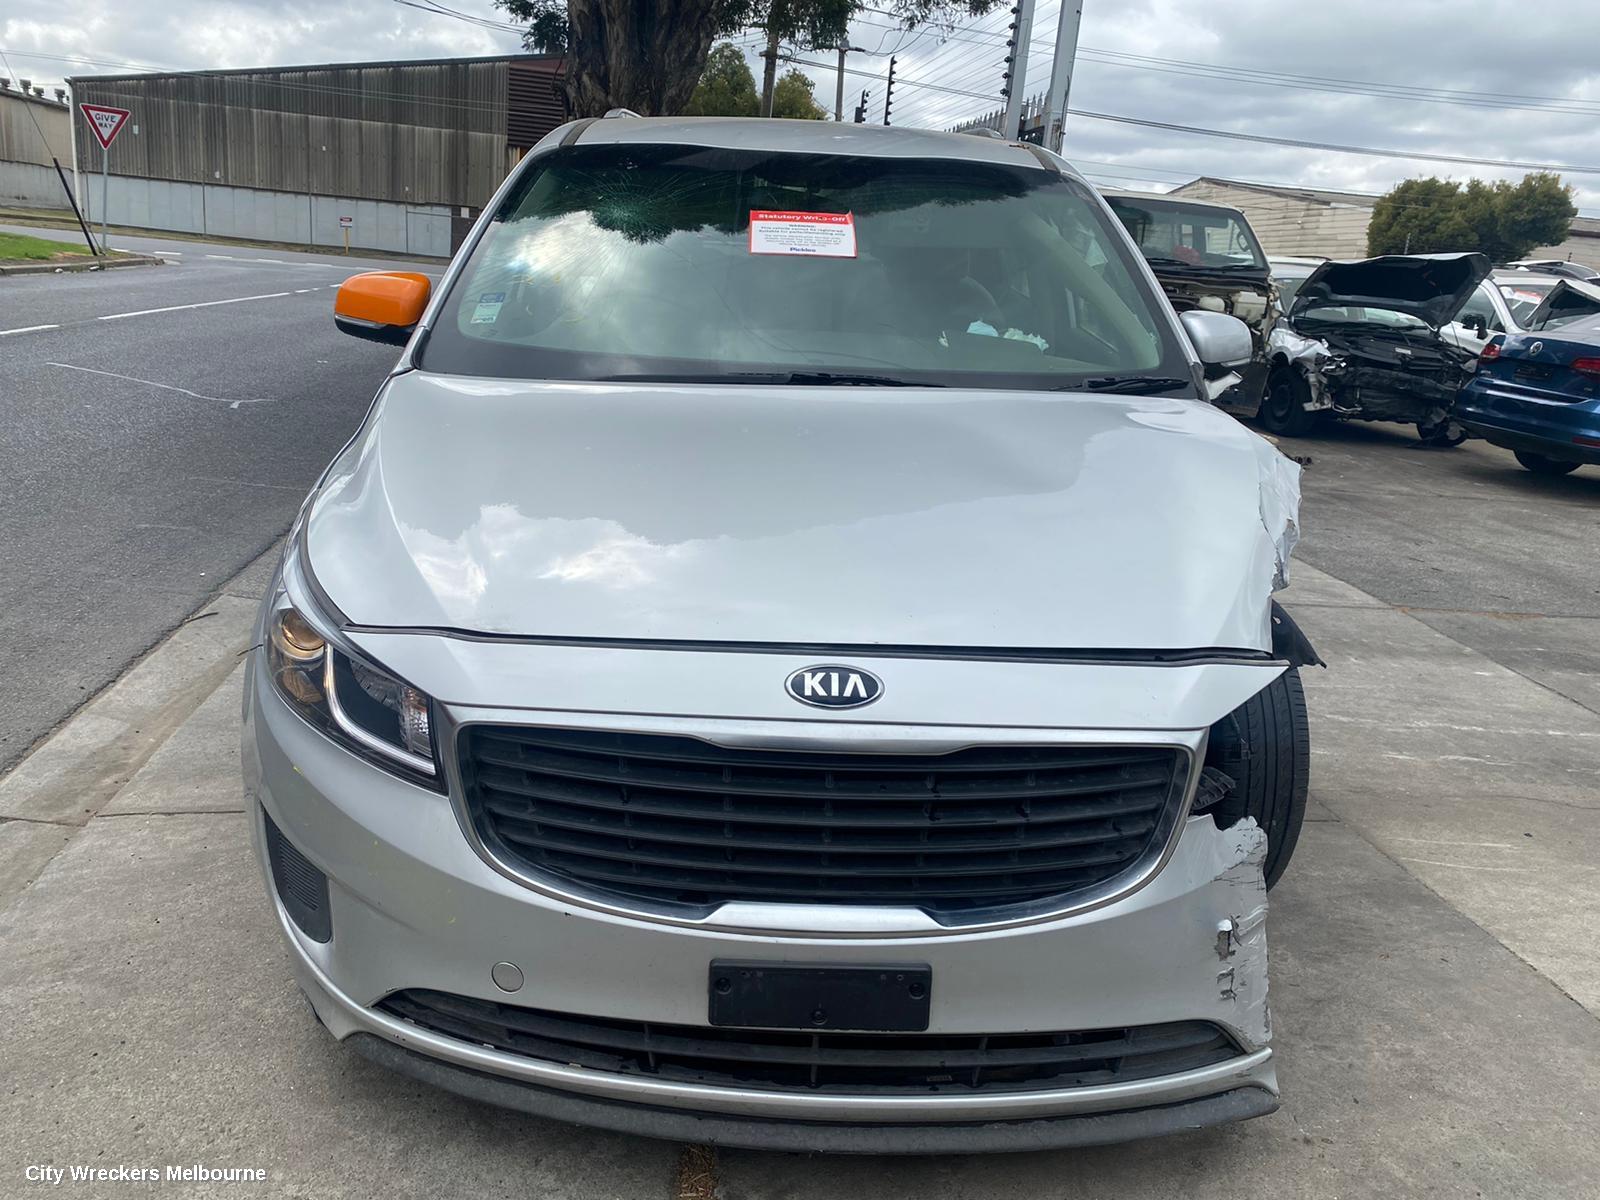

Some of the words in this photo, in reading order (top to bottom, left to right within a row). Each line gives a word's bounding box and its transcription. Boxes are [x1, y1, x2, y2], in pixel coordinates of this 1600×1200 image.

[95, 113, 116, 123] GIVE
[758, 213, 801, 221] Statutory
[802, 672, 868, 698] KIA
